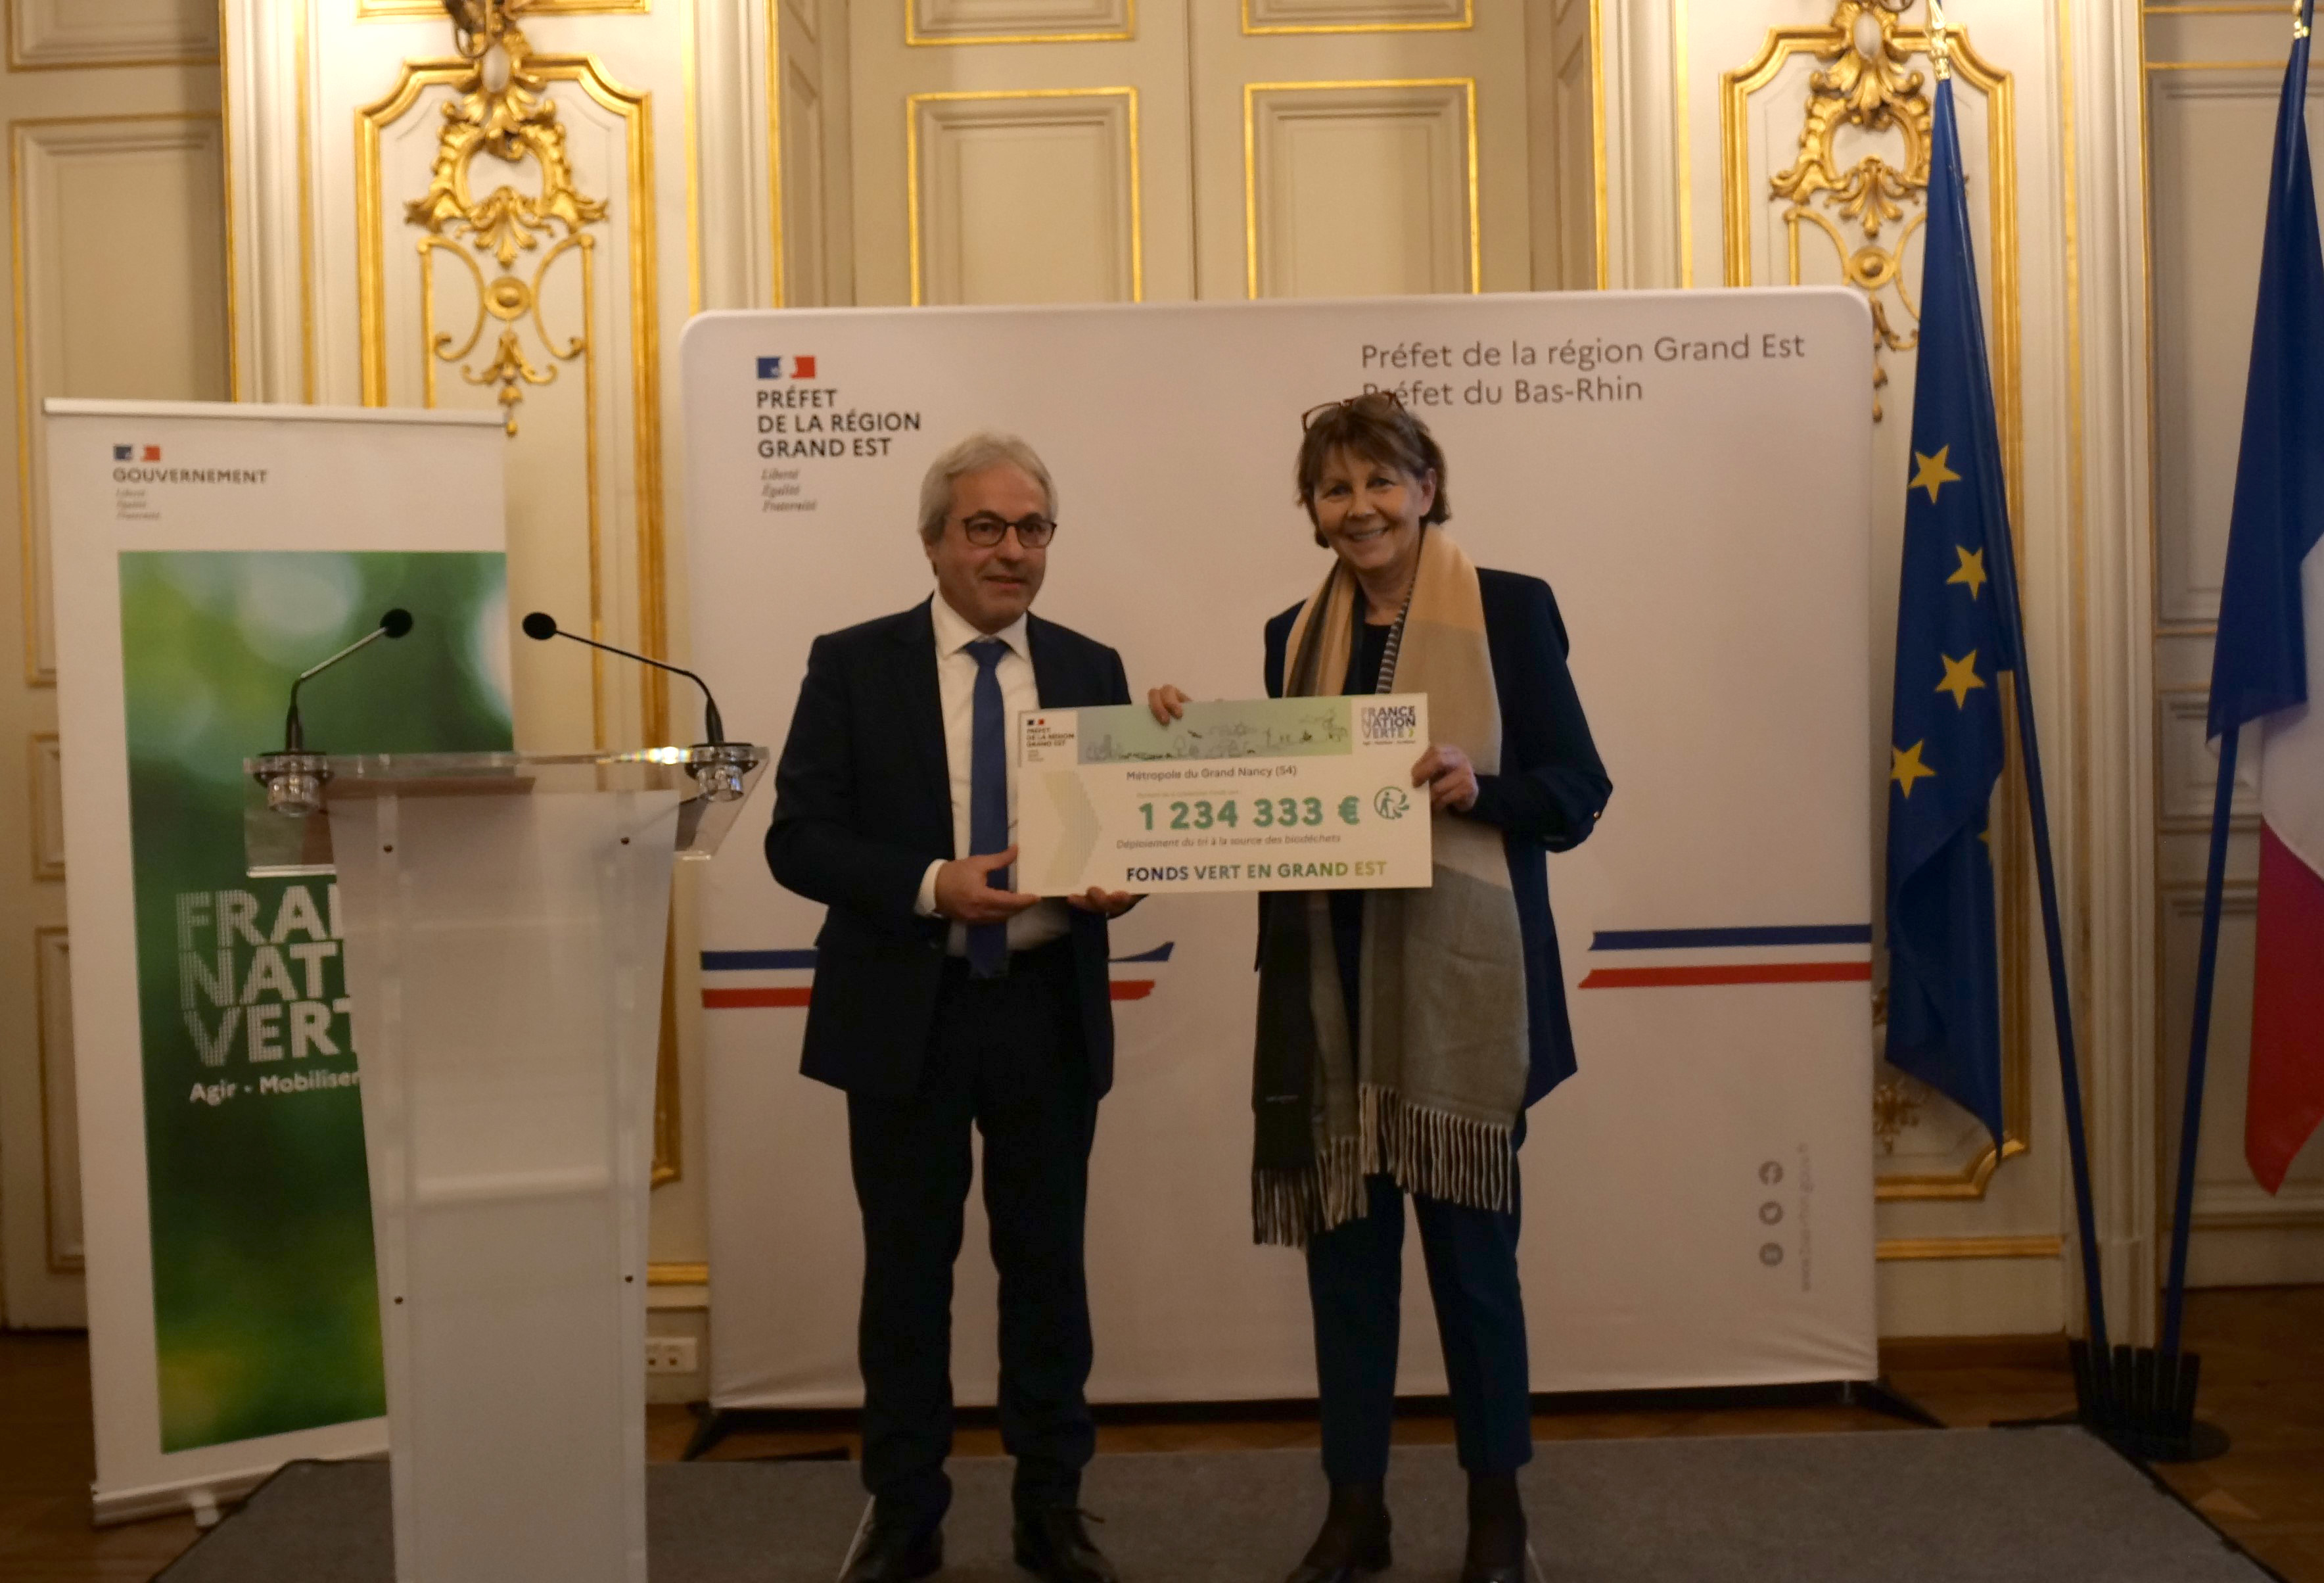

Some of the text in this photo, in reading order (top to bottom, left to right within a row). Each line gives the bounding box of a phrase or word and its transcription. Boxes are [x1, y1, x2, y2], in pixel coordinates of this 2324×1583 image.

[1362, 333, 1805, 372] Préfet de la région Grand Est
[756, 385, 837, 409] PRÉFET
[1464, 378, 1502, 406] du
[1515, 376, 1644, 404] Bas-Rhin
[758, 408, 921, 434] DE LA RÉGION
[757, 437, 891, 459] GRAND EST
[112, 466, 267, 484] GOUVERNEMENT
[1126, 765, 1297, 782] Métropole du Grand Nancy (54)
[1138, 795, 1361, 831] 1 234 333 €
[1182, 837, 1194, 847] du
[1230, 837, 1263, 846] source
[1265, 835, 1282, 845] des
[1126, 861, 1387, 882] FONDS VERT EN GRAND EST
[175, 884, 344, 951] FRA
[189, 1078, 237, 1106] Agir
